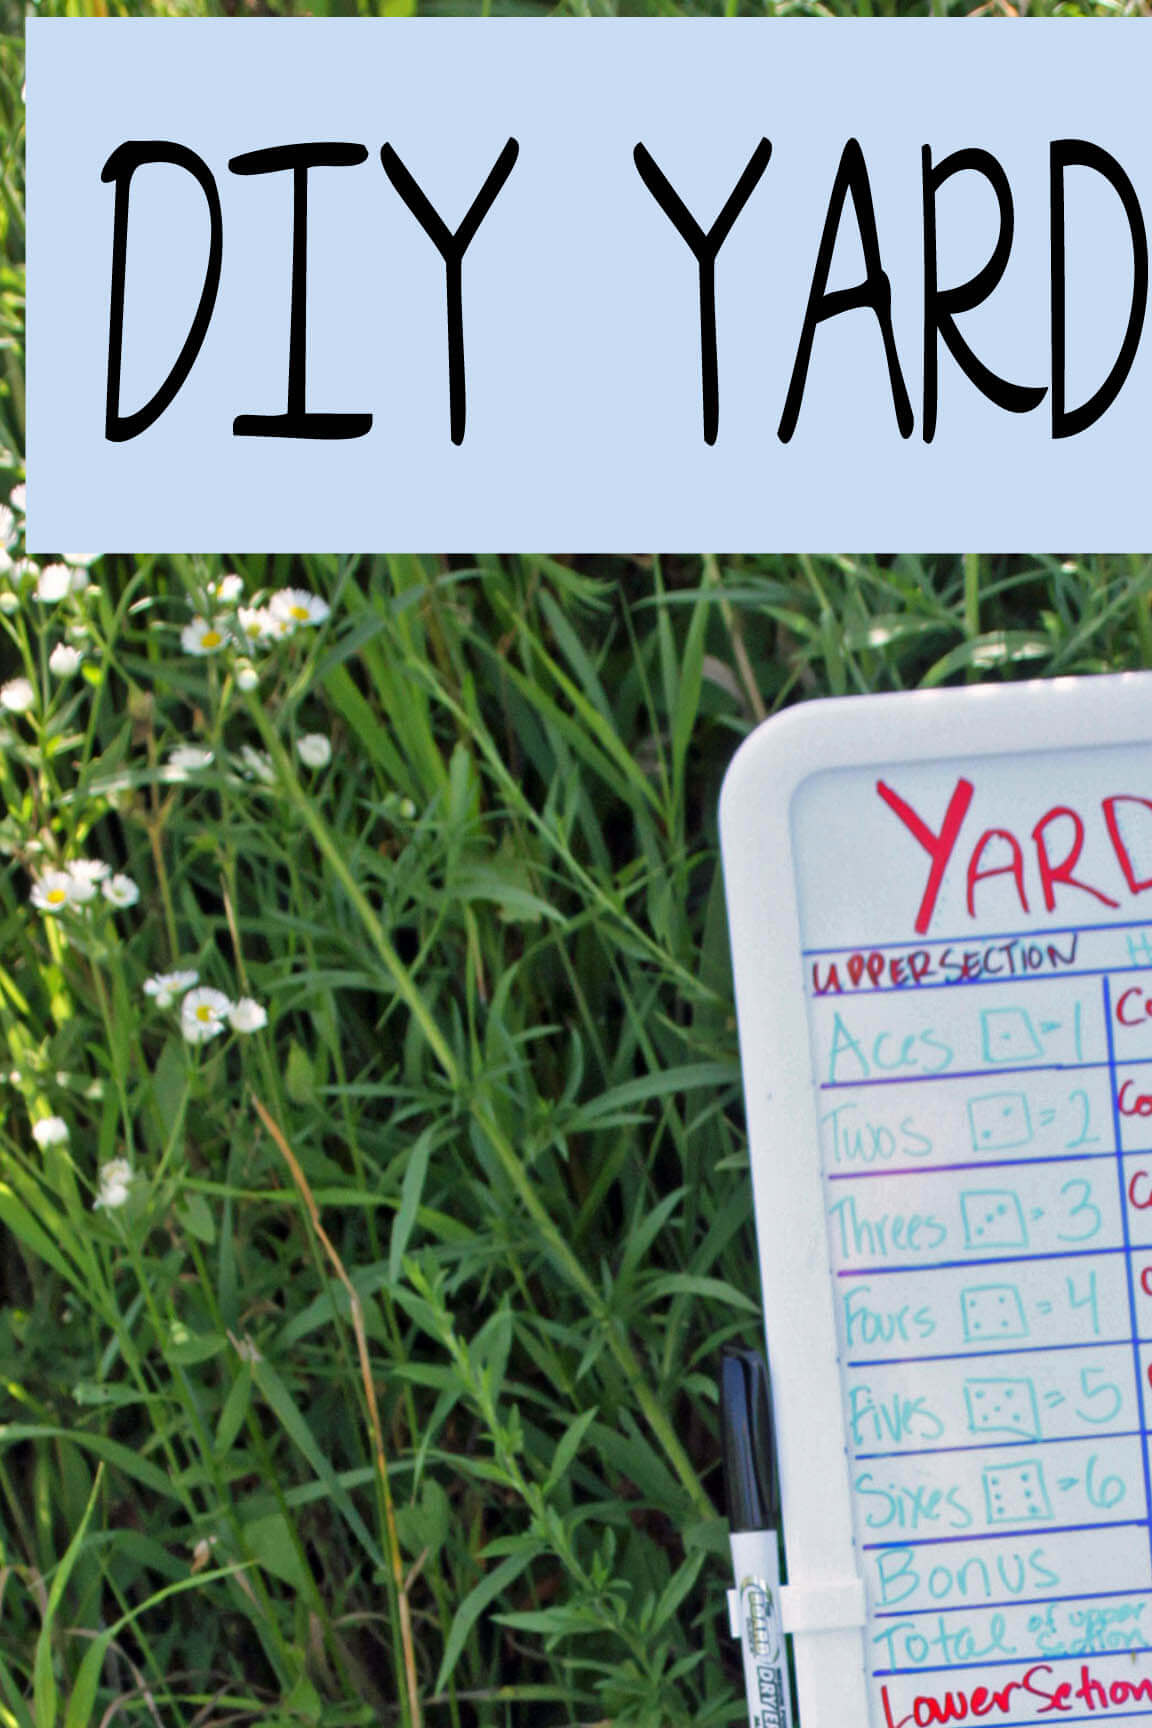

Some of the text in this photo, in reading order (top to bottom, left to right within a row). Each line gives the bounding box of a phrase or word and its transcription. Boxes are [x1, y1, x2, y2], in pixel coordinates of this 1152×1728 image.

[828, 1011, 955, 1084] Aces
[820, 1103, 933, 1163] Twos
[828, 1195, 948, 1259] Threes
[844, 1285, 937, 1348] Fours
[850, 1384, 946, 1446] Fives
[855, 1472, 973, 1529] Sixes
[872, 1613, 1017, 1673] Total
[757, 1665, 778, 1707] DRY
